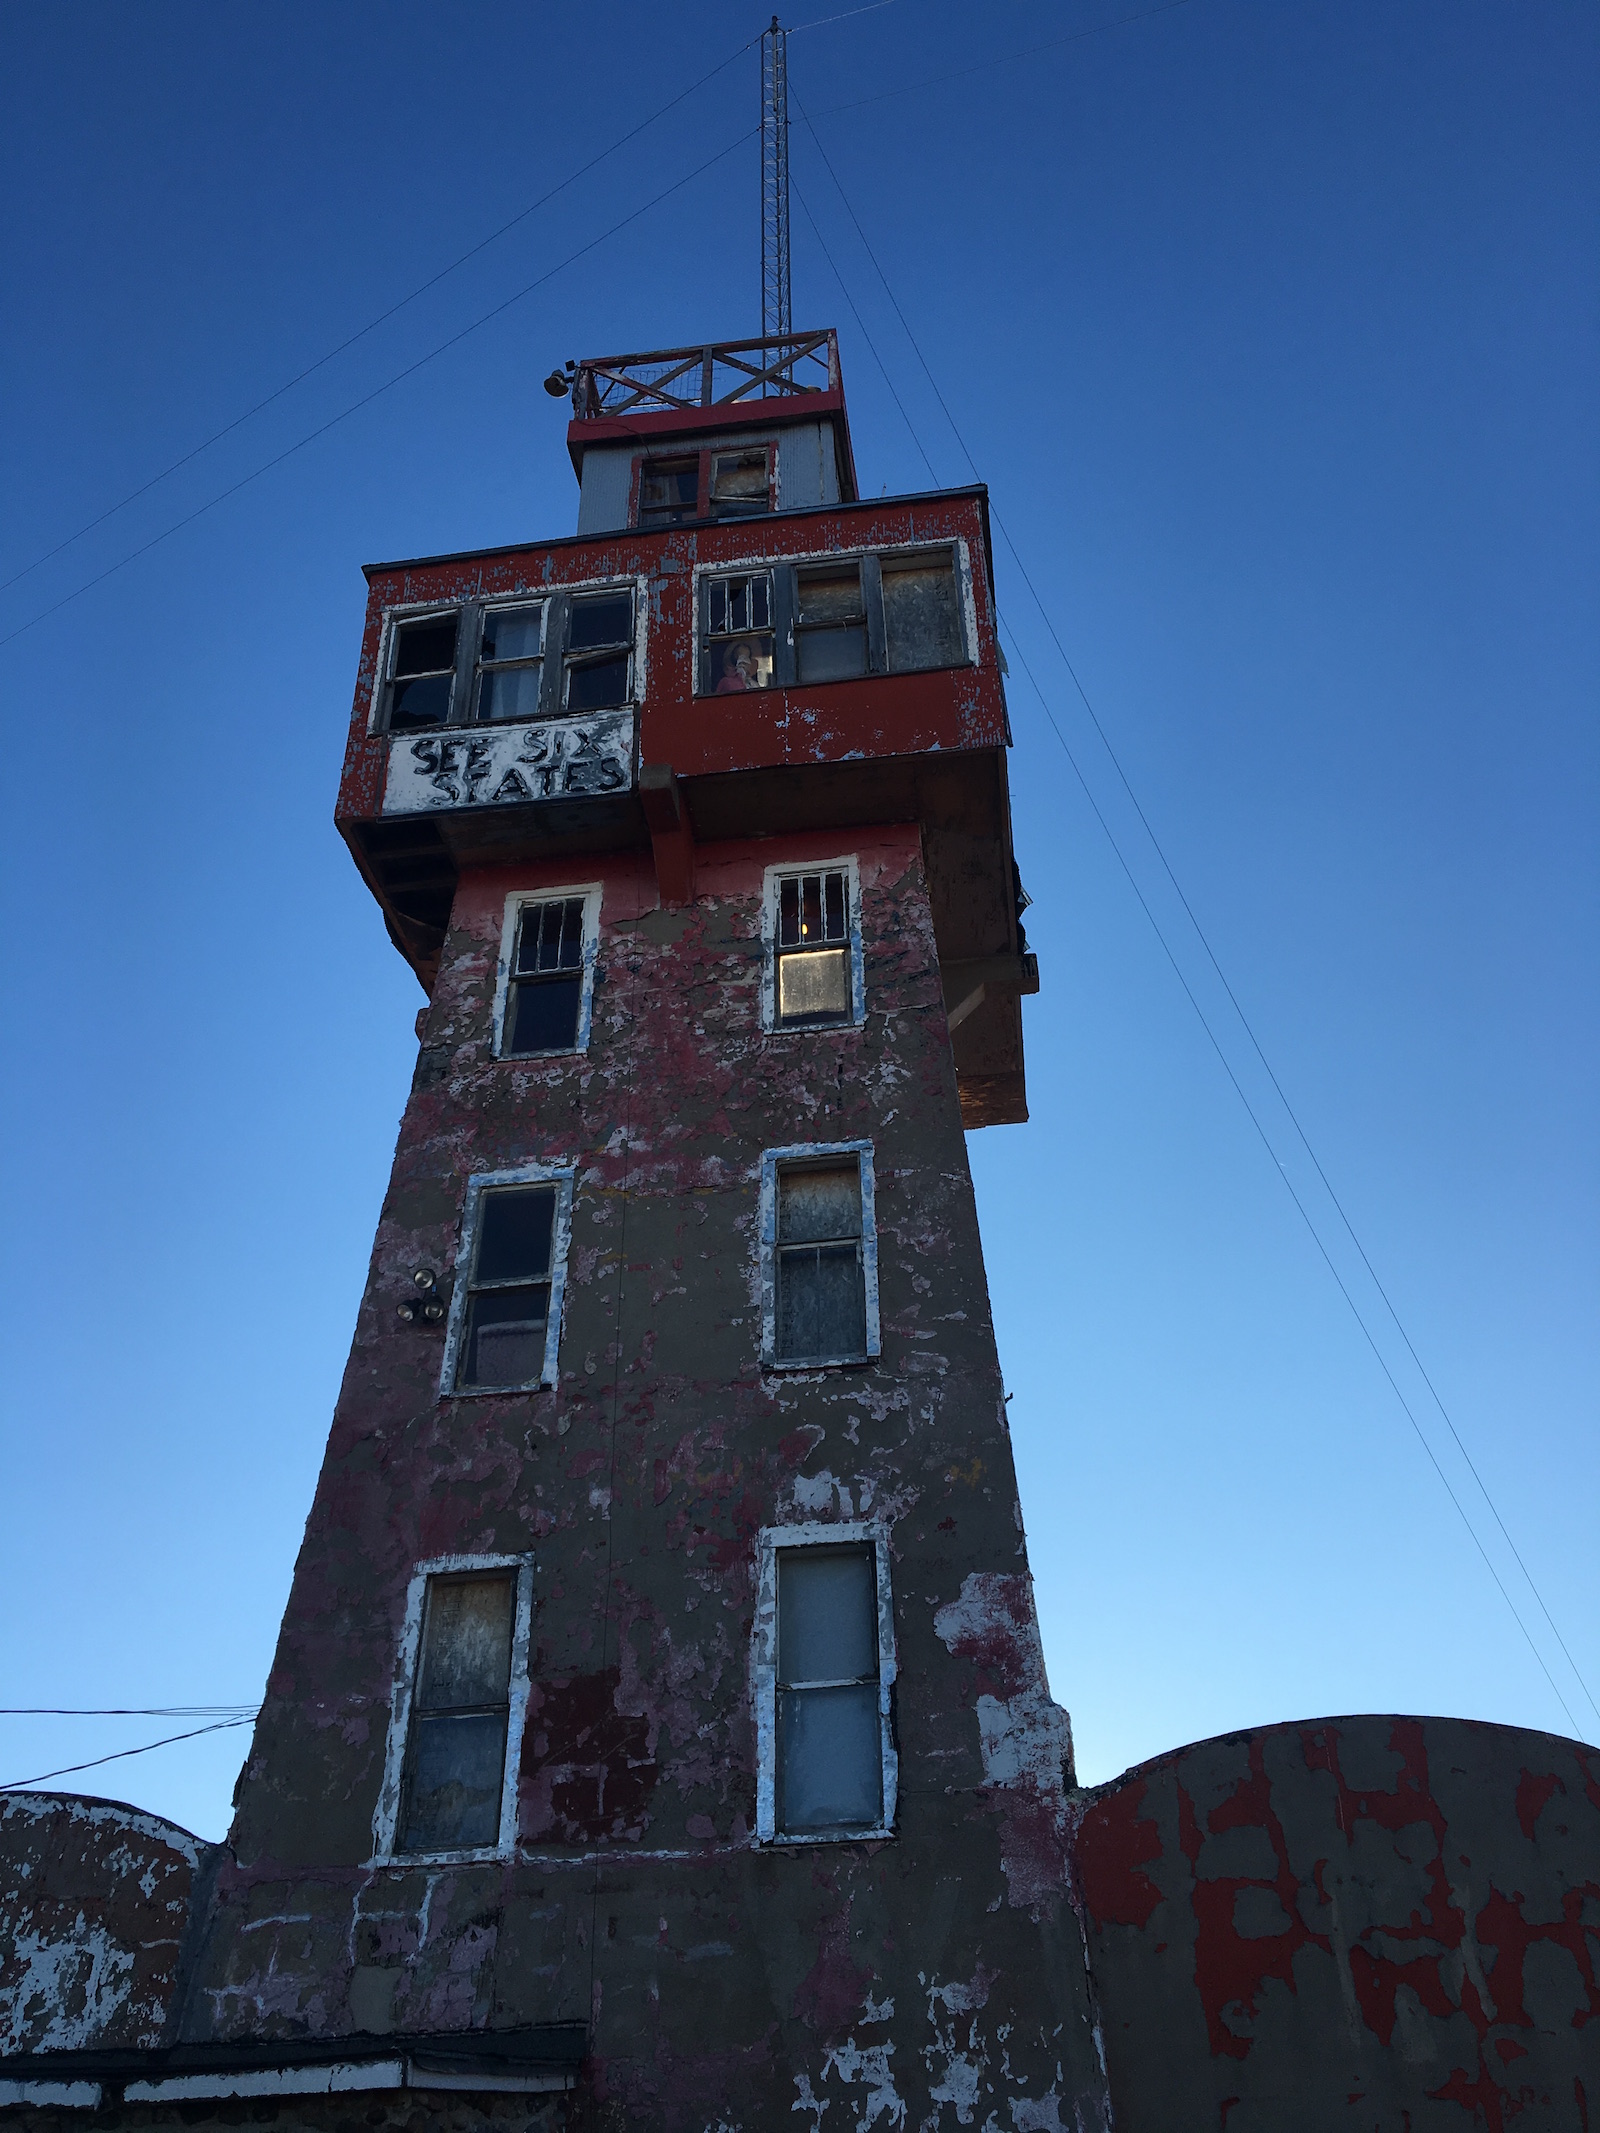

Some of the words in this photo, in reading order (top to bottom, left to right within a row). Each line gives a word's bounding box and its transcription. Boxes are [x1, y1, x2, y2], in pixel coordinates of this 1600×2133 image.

[410, 738, 492, 775] SEE
[516, 728, 605, 762] SIX
[431, 757, 625, 805] STATES
